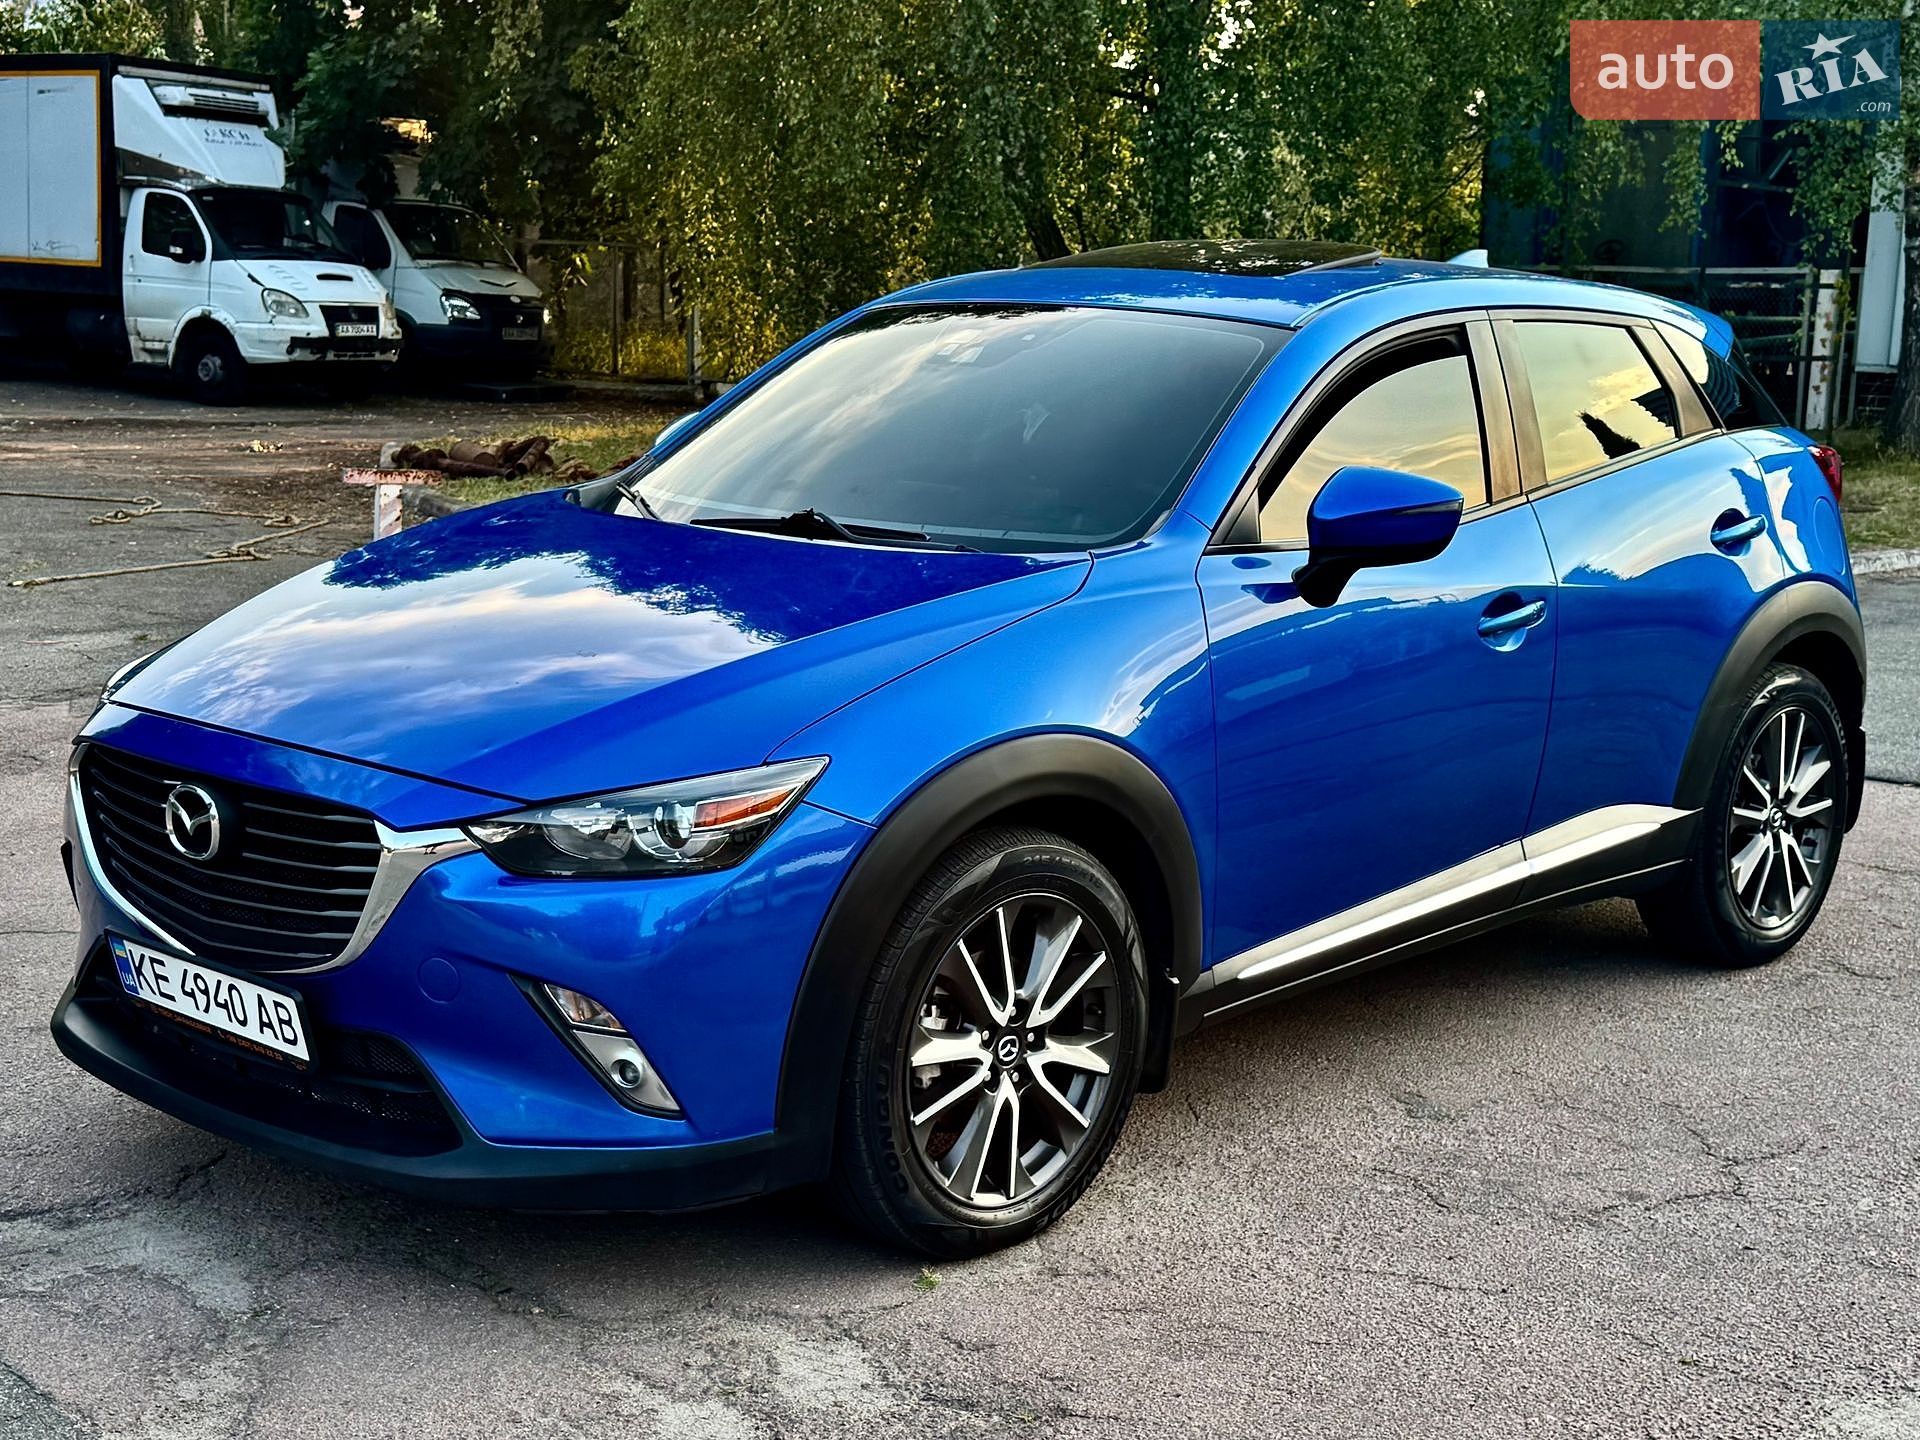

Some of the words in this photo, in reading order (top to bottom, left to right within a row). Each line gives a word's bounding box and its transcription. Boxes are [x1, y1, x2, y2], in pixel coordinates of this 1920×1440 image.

[121, 970, 136, 988] UA
[127, 948, 177, 1003] KE
[180, 968, 248, 1028] 4940
[256, 992, 299, 1047] AB
